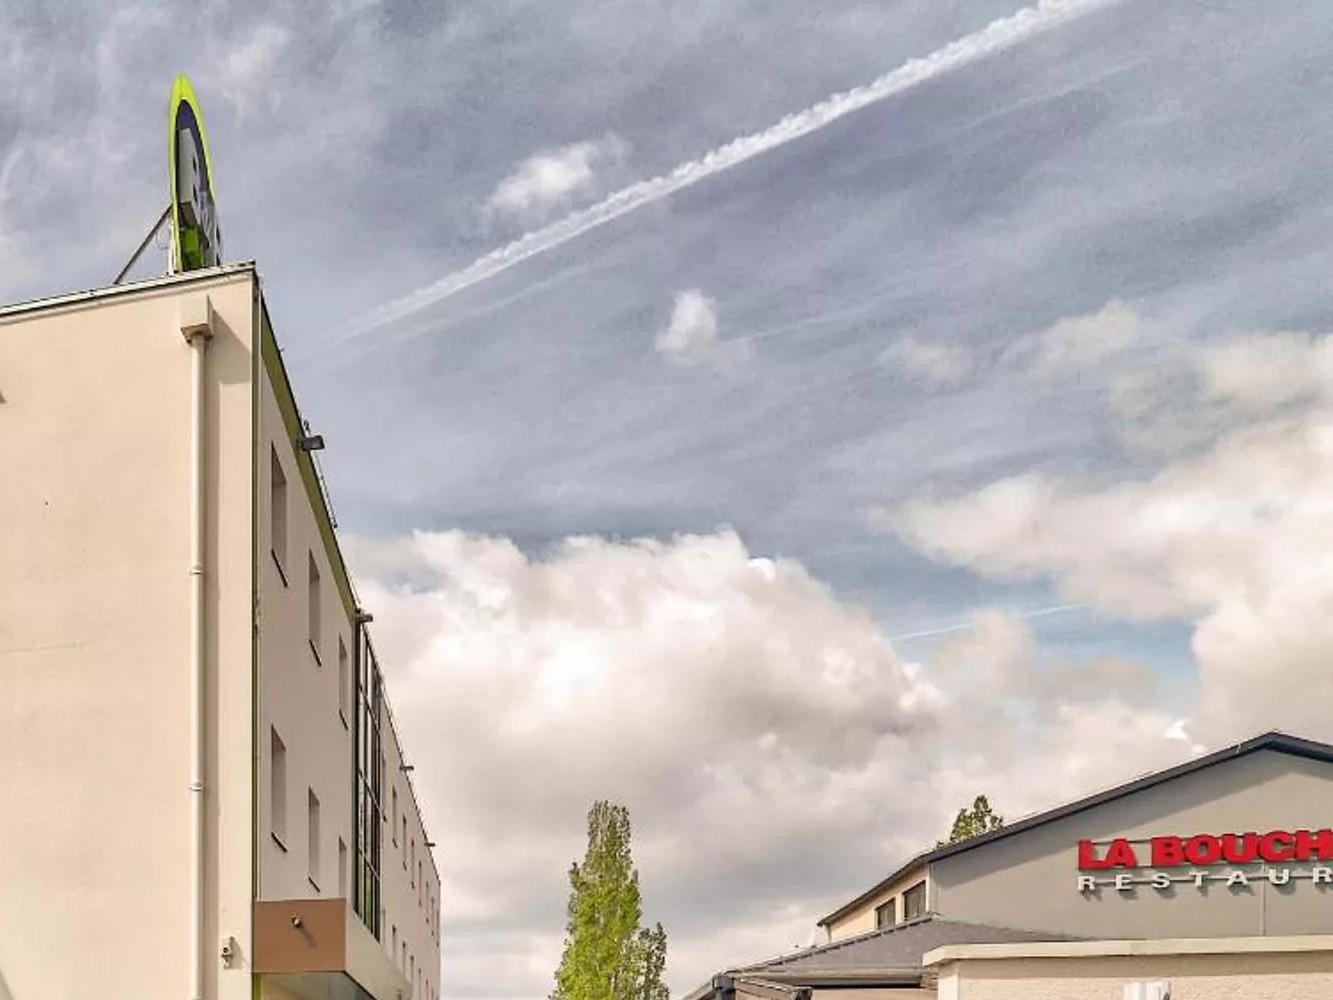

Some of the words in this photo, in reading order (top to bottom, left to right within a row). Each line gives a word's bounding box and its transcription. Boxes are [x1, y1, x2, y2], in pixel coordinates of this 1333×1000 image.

[1078, 838, 1137, 870] LA
[1151, 829, 1333, 868] BOUCH
[1077, 866, 1333, 891] RESTAUR
